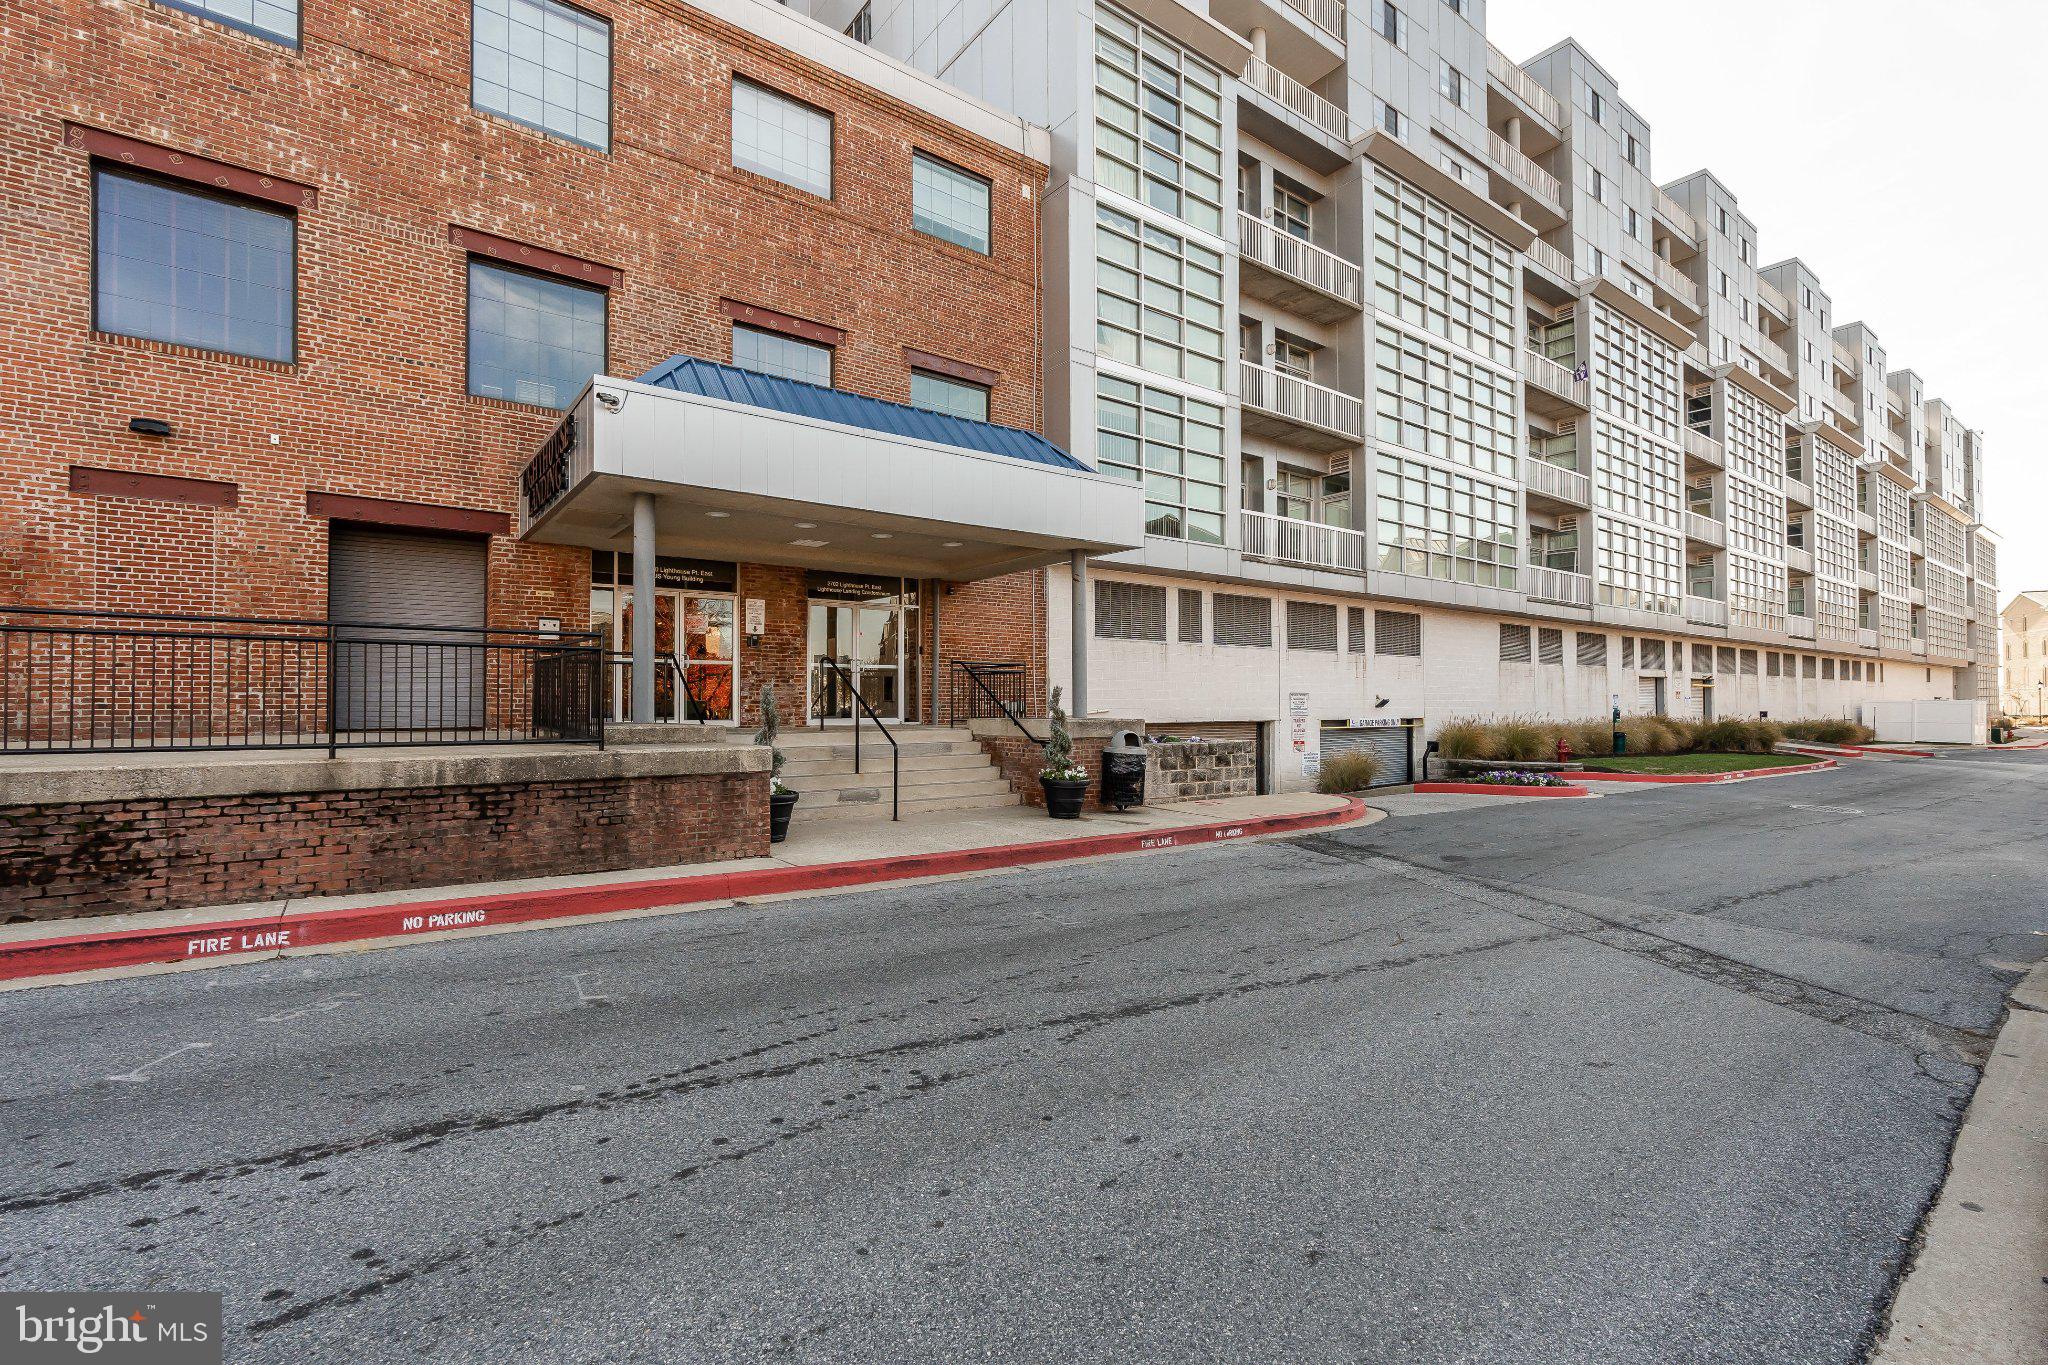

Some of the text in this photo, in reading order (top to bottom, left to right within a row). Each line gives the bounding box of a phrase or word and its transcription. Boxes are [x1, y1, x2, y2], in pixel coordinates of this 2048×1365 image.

[660, 567, 691, 575] Lighthouse
[663, 573, 681, 582] Young
[682, 575, 704, 584] Building
[817, 586, 842, 594] Lighthouse
[843, 588, 861, 596] Landing
[840, 582, 864, 590] Lighthouse
[1360, 719, 1374, 727] GARAGE
[1375, 719, 1390, 727] PARKING
[1141, 837, 1173, 848] FIRE LANE
[402, 909, 486, 931] NO PARKING
[188, 930, 291, 955] FIRE LANE
